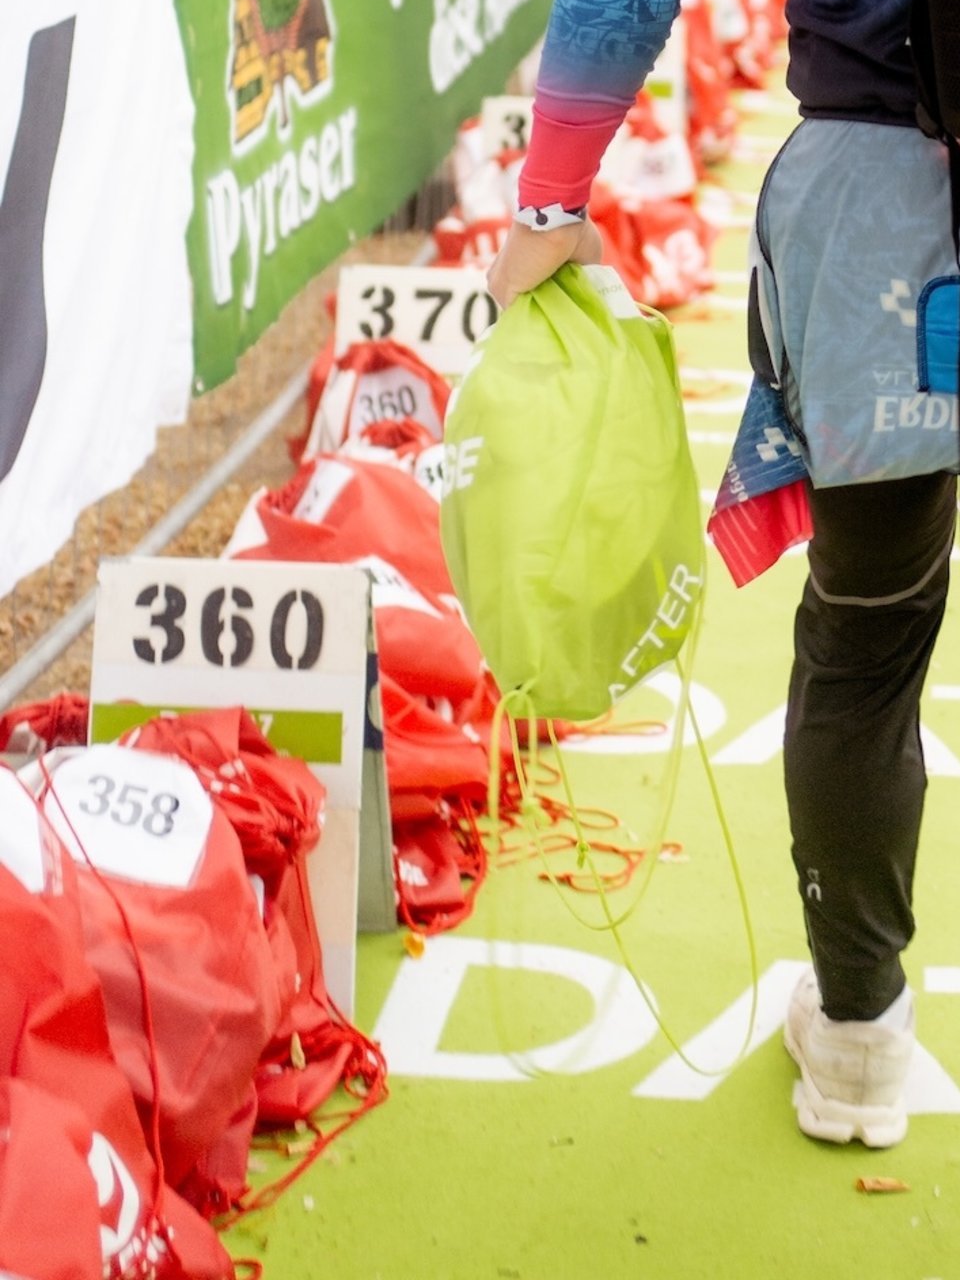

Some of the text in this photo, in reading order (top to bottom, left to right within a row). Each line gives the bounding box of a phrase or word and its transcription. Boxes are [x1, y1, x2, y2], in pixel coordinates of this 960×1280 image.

[207, 106, 358, 307] Pyraser
[359, 286, 499, 343] 370
[132, 583, 325, 671] 360
[78, 774, 180, 838] 358
